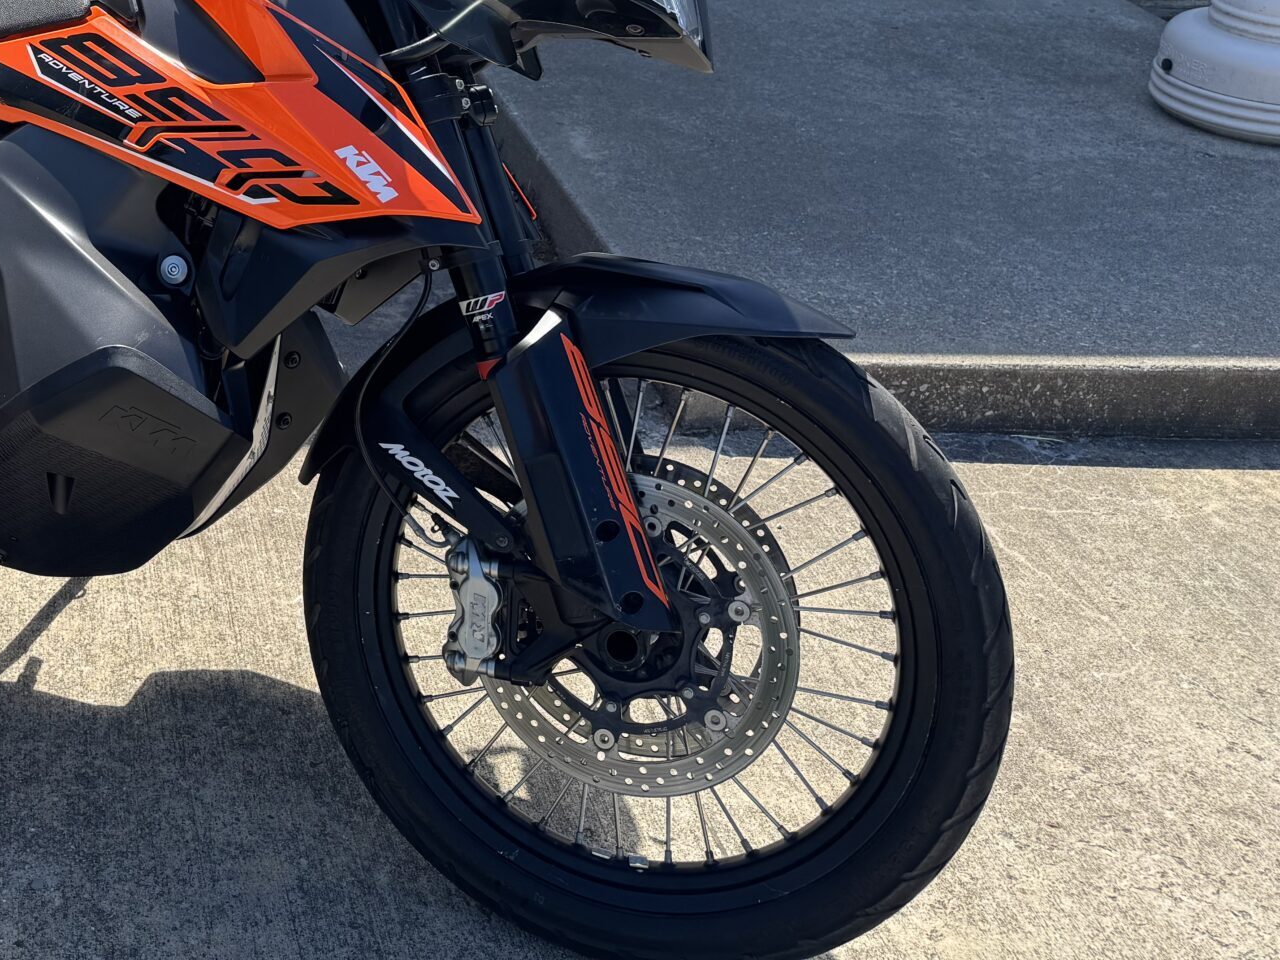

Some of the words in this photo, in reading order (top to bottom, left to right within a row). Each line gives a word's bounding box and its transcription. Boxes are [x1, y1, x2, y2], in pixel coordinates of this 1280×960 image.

[36, 52, 143, 119] ADVENTURE
[333, 144, 399, 204] KTM
[459, 291, 506, 315] WP
[472, 312, 494, 323] APEX
[378, 443, 461, 510] MOTOZ
